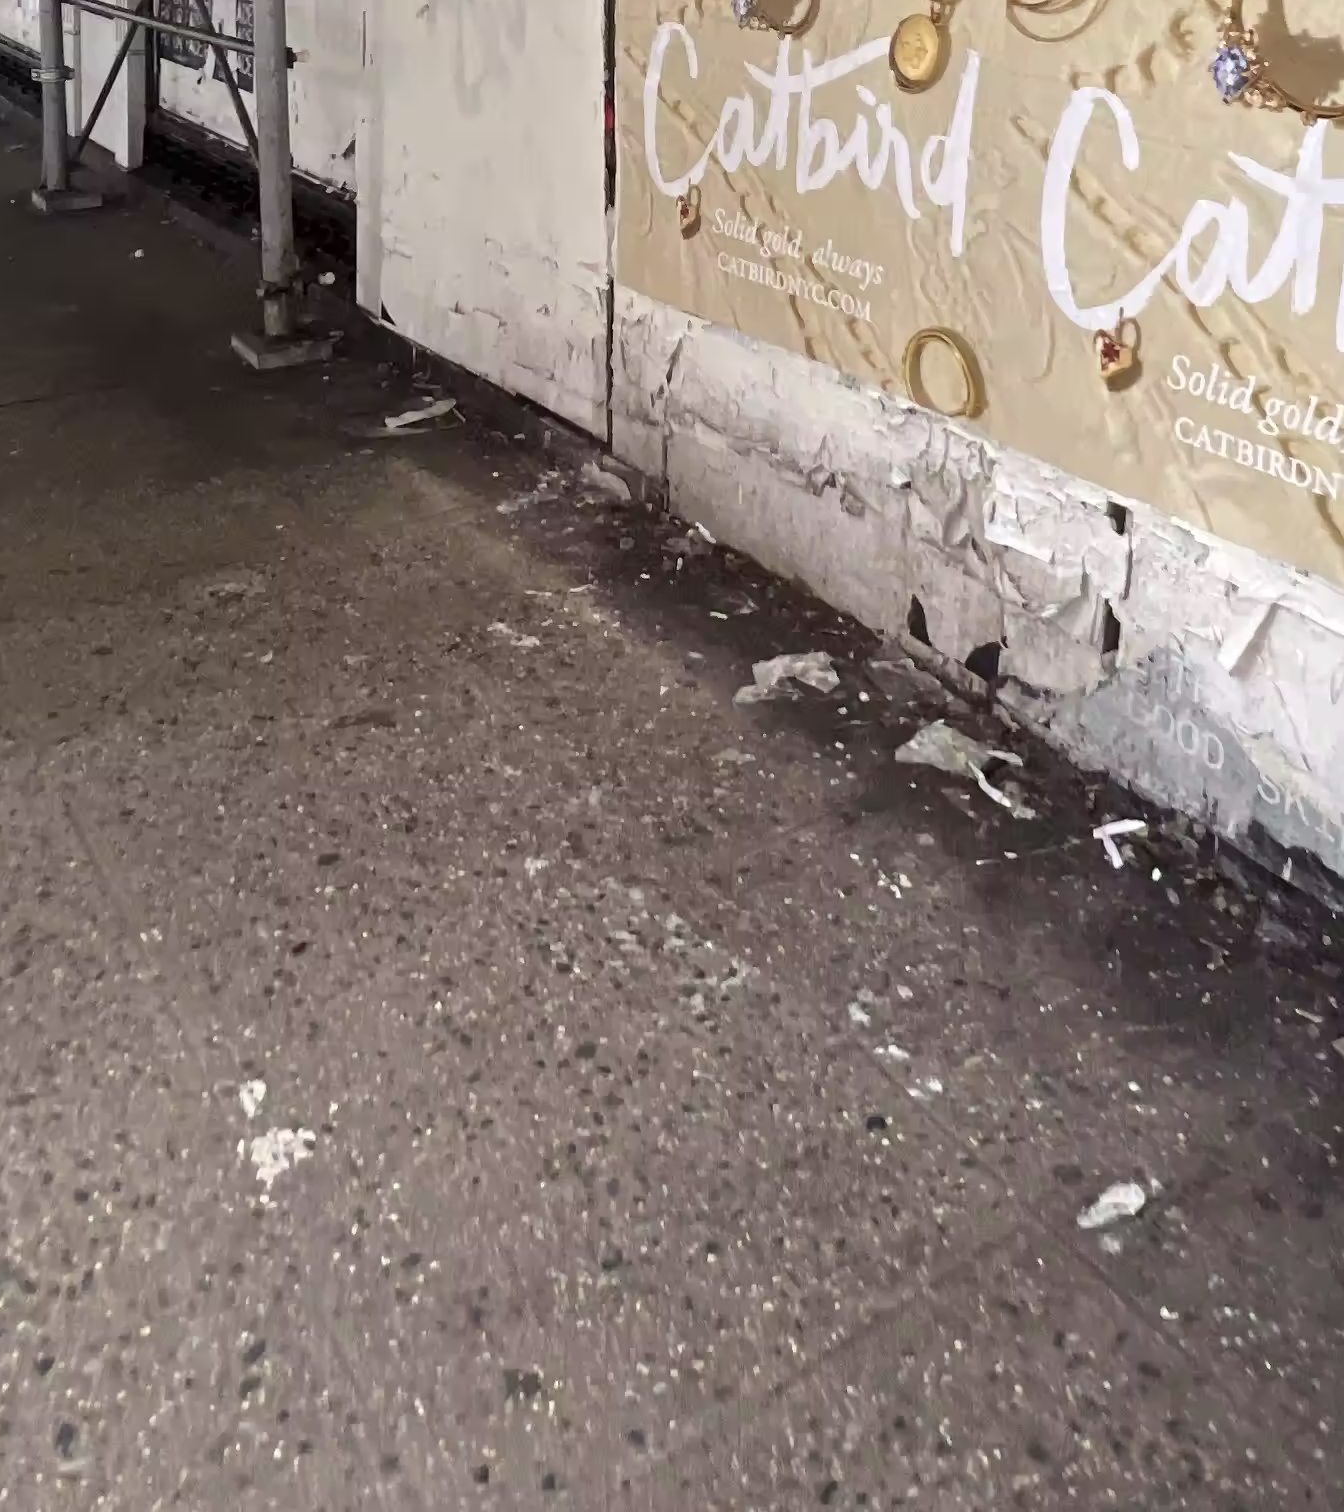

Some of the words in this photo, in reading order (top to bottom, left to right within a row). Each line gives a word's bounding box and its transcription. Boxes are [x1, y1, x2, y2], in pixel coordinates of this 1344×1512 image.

[644, 21, 980, 257] Catbird
[712, 208, 758, 244] Solid
[812, 239, 885, 290] always
[716, 252, 872, 322] CATBIRDNYC.COM
[1166, 354, 1256, 415] Solid
